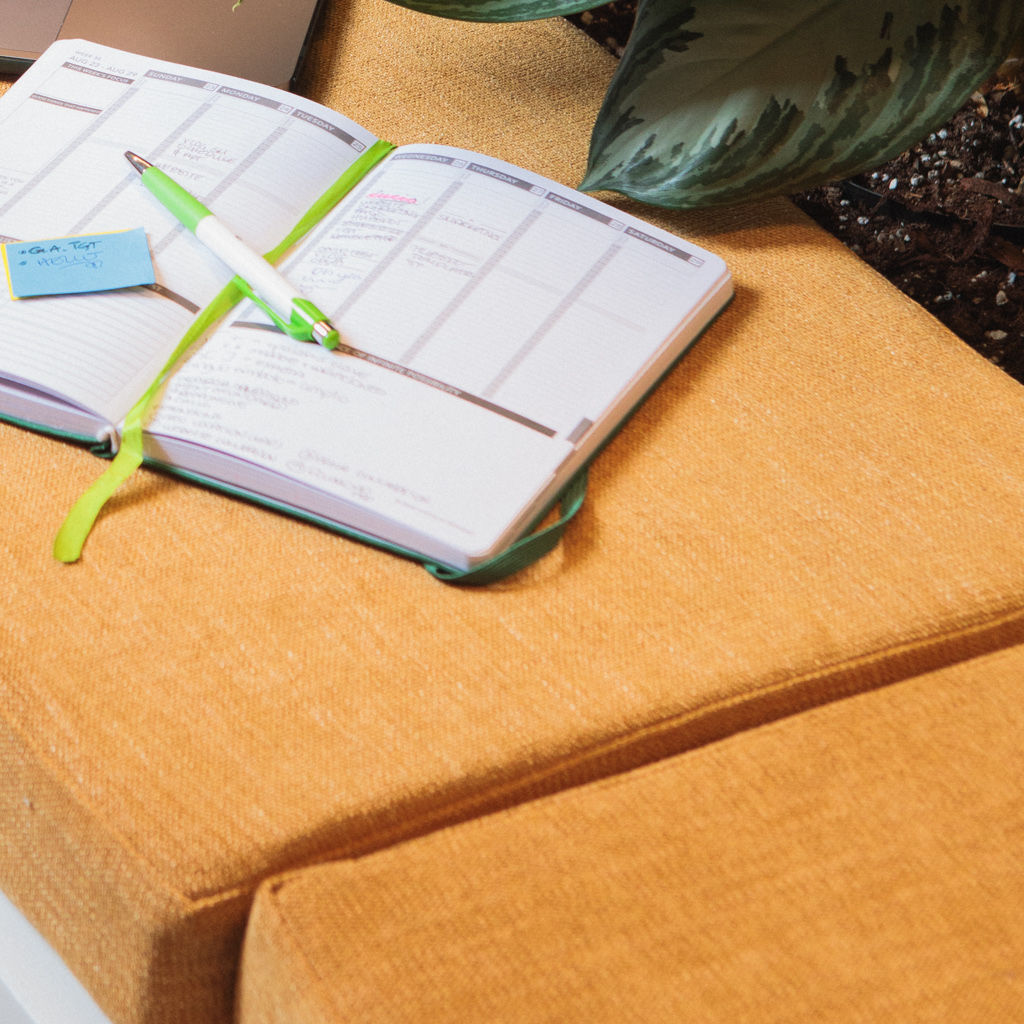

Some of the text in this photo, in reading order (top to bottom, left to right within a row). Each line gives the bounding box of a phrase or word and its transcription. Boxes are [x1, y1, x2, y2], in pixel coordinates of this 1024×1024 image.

[66, 64, 82, 72] THIS
[68, 54, 90, 65] AUG
[106, 66, 126, 76] AUG
[148, 72, 183, 82] SUNDAY
[221, 88, 261, 102] MONDAY
[295, 111, 365, 151] TUESDAY 25
[393, 154, 449, 163] WEDNESDAY
[470, 164, 519, 184] THURSDAY
[548, 194, 582, 211] FRIDAY
[628, 228, 676, 254] SATURDAY
